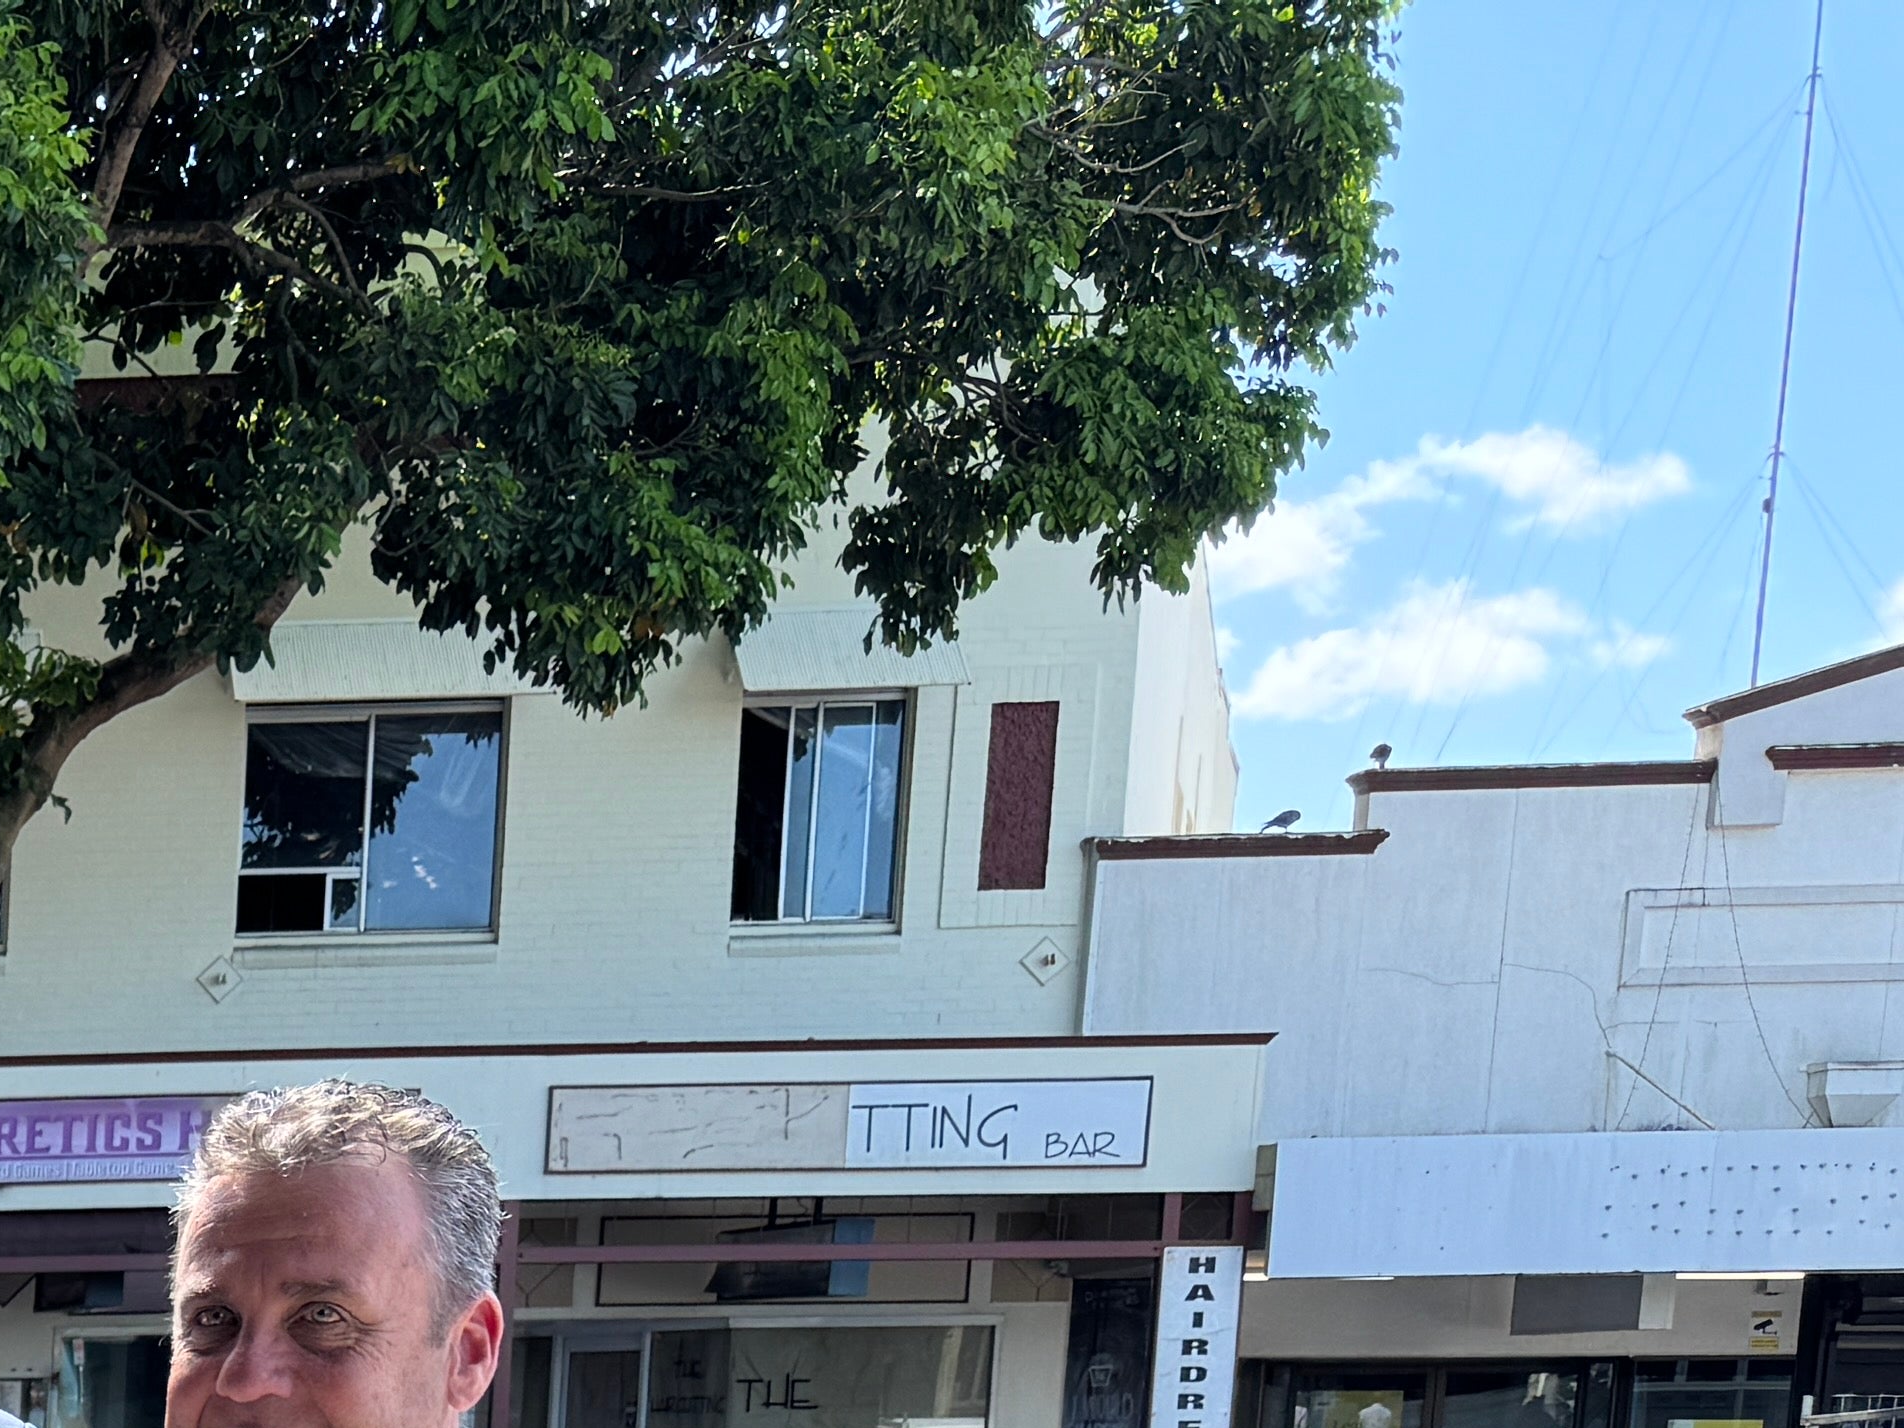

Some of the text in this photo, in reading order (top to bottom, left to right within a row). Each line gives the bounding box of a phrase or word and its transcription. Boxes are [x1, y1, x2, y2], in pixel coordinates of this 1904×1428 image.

[1044, 1131, 1121, 1159] BAR
[134, 1160, 176, 1175] Game
[736, 1372, 819, 1413] THE
